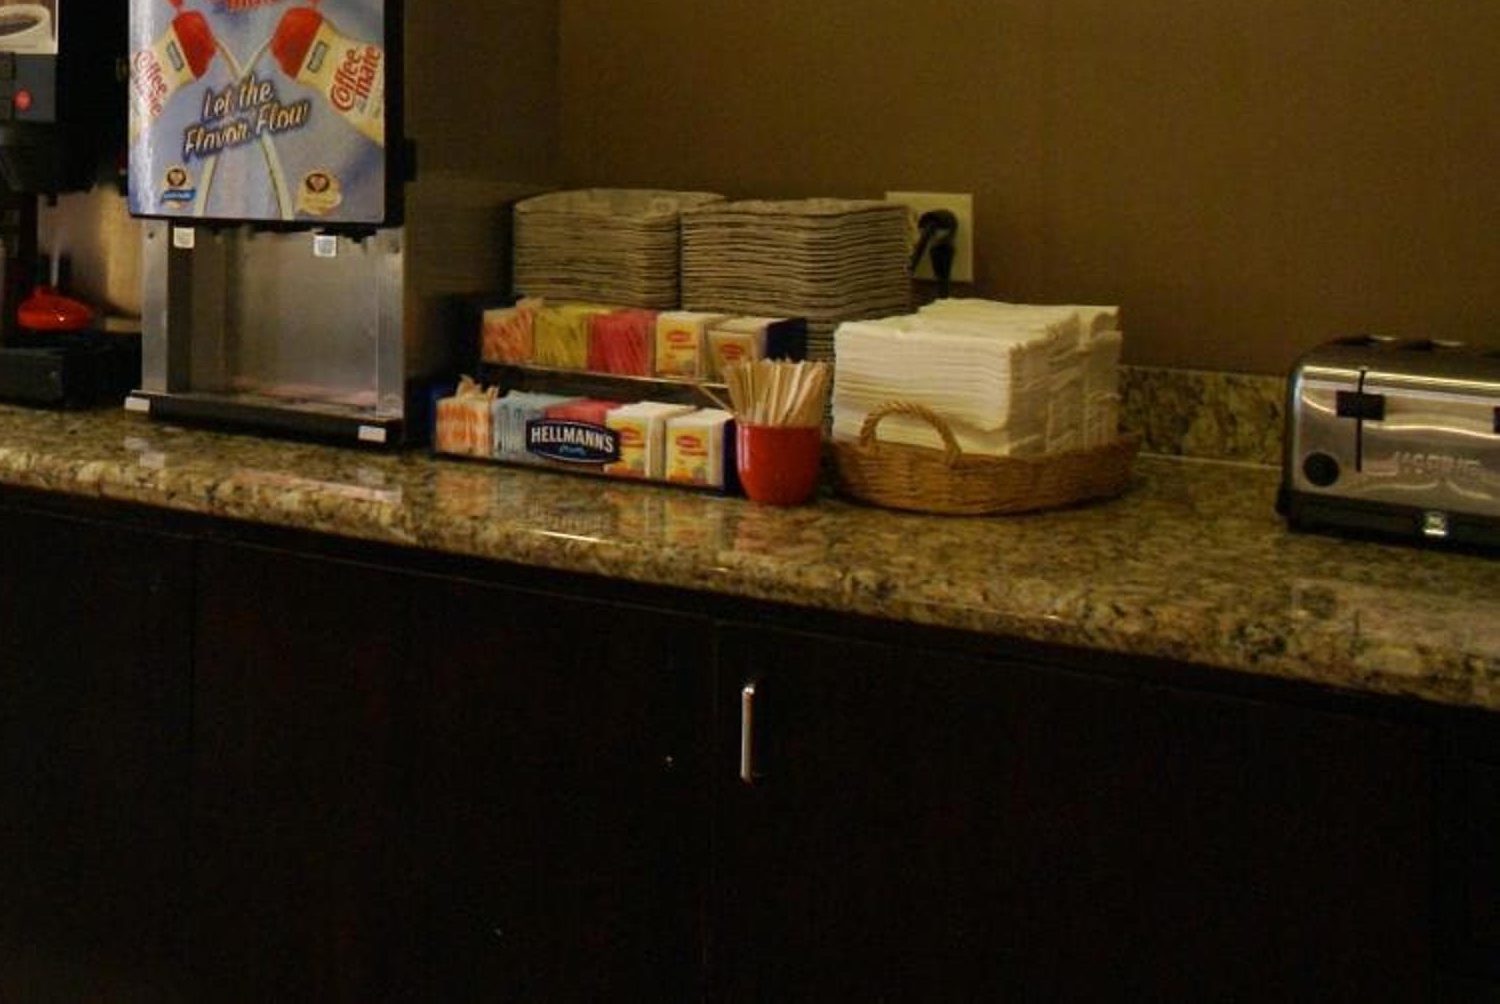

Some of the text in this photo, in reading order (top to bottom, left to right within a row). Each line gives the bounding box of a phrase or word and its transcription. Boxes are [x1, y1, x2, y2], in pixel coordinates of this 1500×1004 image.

[202, 73, 275, 119] Let the
[330, 48, 362, 113] Coffee
[355, 45, 382, 100] mate
[255, 100, 309, 135] Flow
